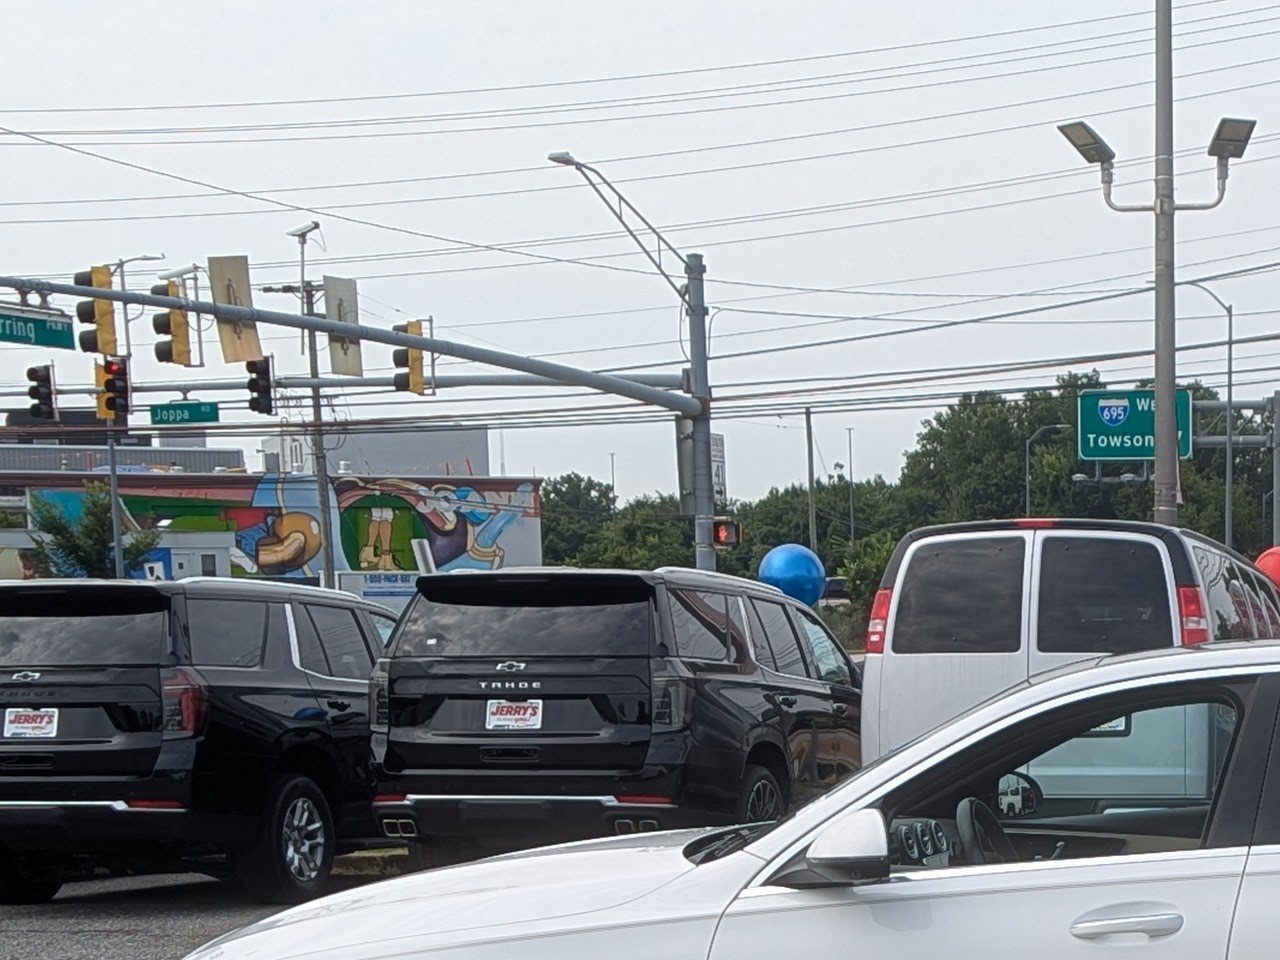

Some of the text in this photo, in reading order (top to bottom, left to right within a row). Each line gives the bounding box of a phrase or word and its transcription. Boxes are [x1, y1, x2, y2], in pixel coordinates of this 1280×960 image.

[155, 409, 189, 421] Joppa
[1103, 407, 1124, 420] 695
[1087, 434, 1154, 447] Towson
[490, 705, 539, 717] JERRY'S
[9, 713, 55, 725] JERRY'S
